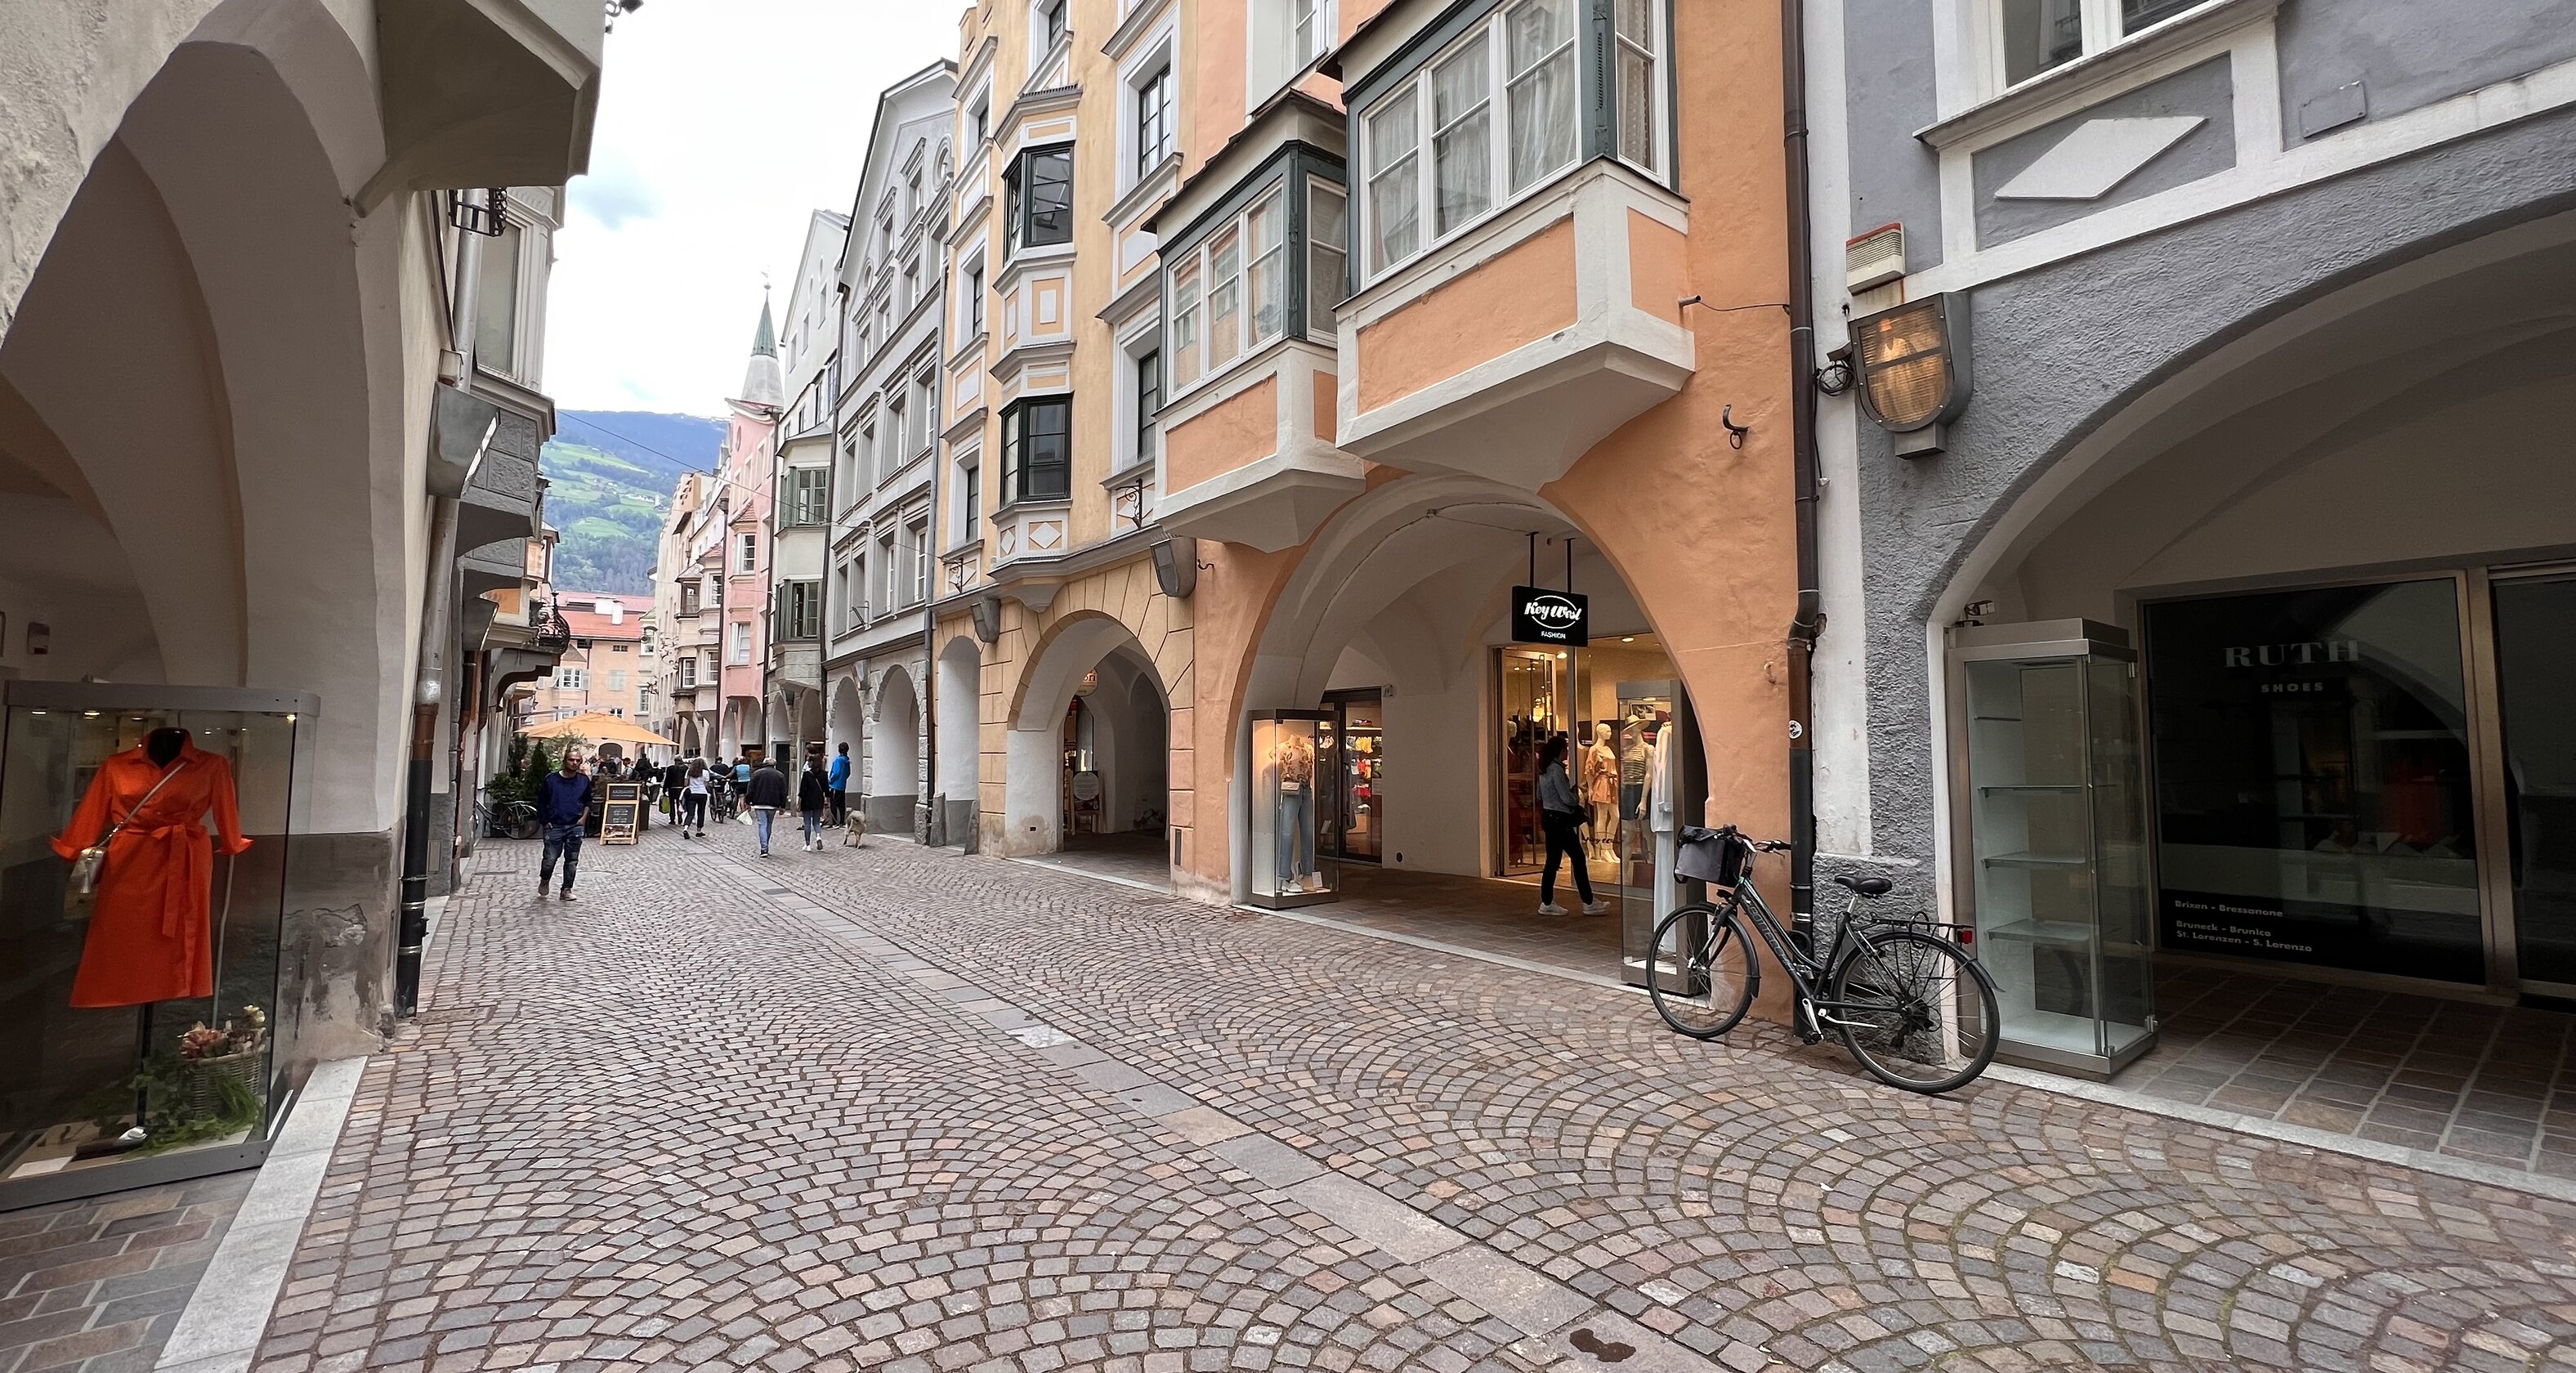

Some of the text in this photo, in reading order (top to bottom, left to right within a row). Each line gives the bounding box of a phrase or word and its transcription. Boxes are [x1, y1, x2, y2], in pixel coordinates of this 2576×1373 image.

[1524, 602, 1582, 620] Key West
[1541, 631, 1566, 639] FASHION
[2223, 639, 2363, 668] RUTH
[2261, 682, 2323, 693] SHOES
[2175, 900, 2208, 910] Brixen
[2219, 904, 2283, 917] Bressanone
[2176, 920, 2218, 932] Bruneck
[2229, 926, 2272, 937] Brunico
[2193, 932, 2242, 944] Lorenzen
[2266, 940, 2313, 952] Lorenzo
